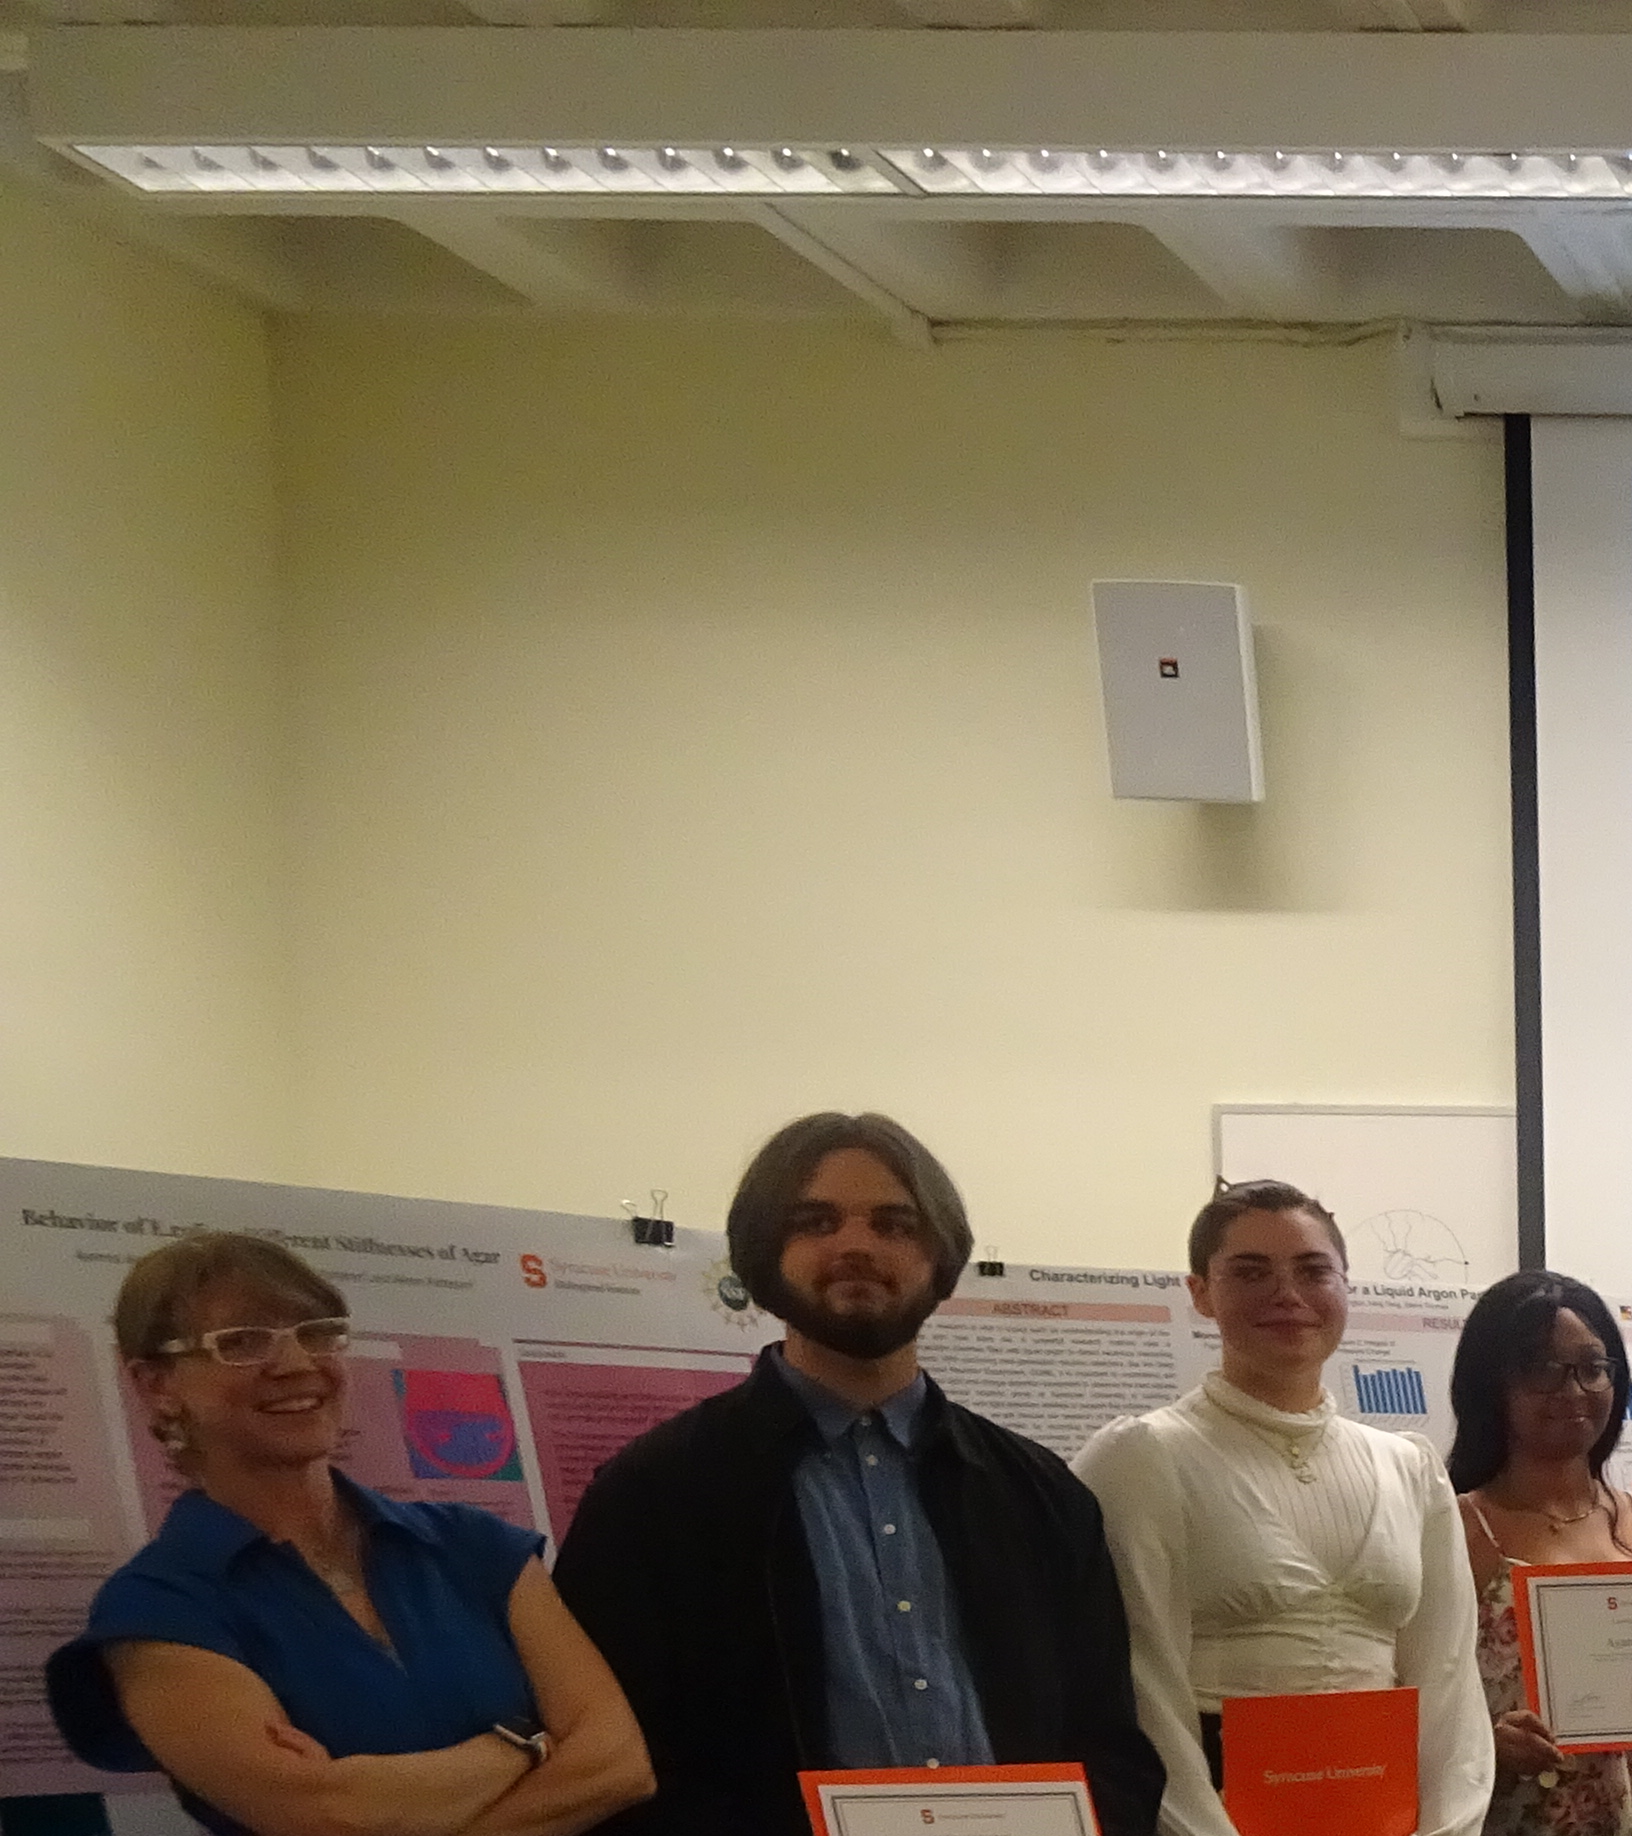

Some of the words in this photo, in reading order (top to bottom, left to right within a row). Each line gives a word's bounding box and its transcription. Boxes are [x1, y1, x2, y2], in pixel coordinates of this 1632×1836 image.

[21, 1208, 118, 1232] Behavior
[462, 1247, 501, 1265] Agar
[520, 1254, 547, 1289] S
[1029, 1268, 1140, 1288] Characterizing
[1143, 1274, 1182, 1289] Light
[1363, 1286, 1370, 1296] a
[1374, 1284, 1415, 1300] Liquid
[1418, 1287, 1457, 1302] Argon
[992, 1303, 1069, 1317] ABSTRACT
[1606, 1596, 1618, 1610] S
[1262, 1769, 1324, 1788] Syracuse
[1326, 1763, 1387, 1782] University
[920, 1808, 935, 1824] S
